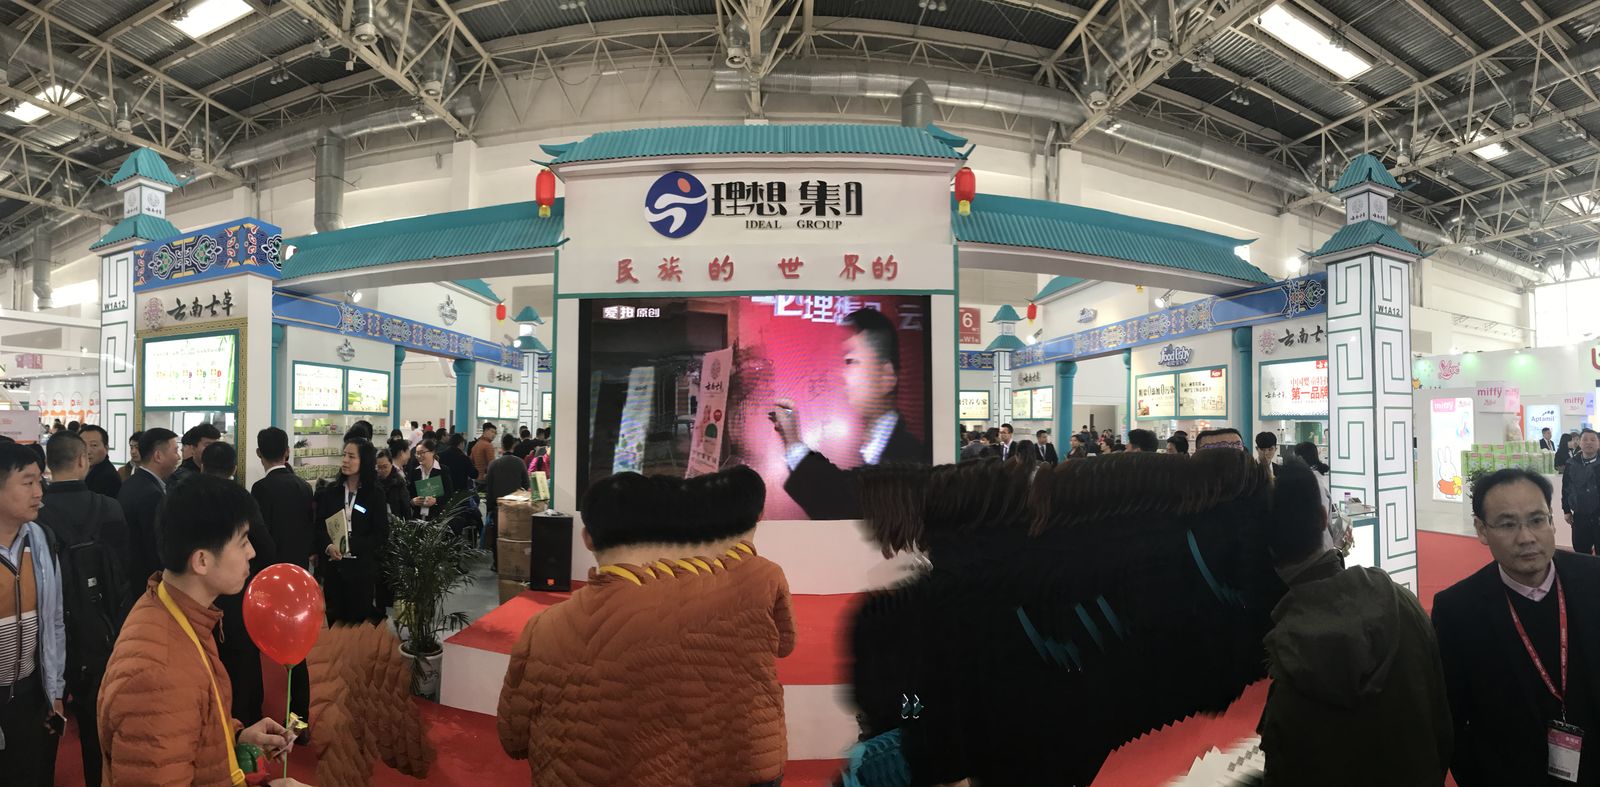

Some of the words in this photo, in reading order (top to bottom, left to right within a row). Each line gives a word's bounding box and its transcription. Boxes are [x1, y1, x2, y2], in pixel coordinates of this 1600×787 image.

[745, 220, 782, 229] IDEAL
[797, 220, 842, 229] GROUP
[104, 300, 126, 310] W1A12
[1378, 304, 1400, 315] W1A12
[962, 312, 973, 328] 6
[1477, 387, 1503, 399] miffy
[1564, 396, 1585, 405] miffy
